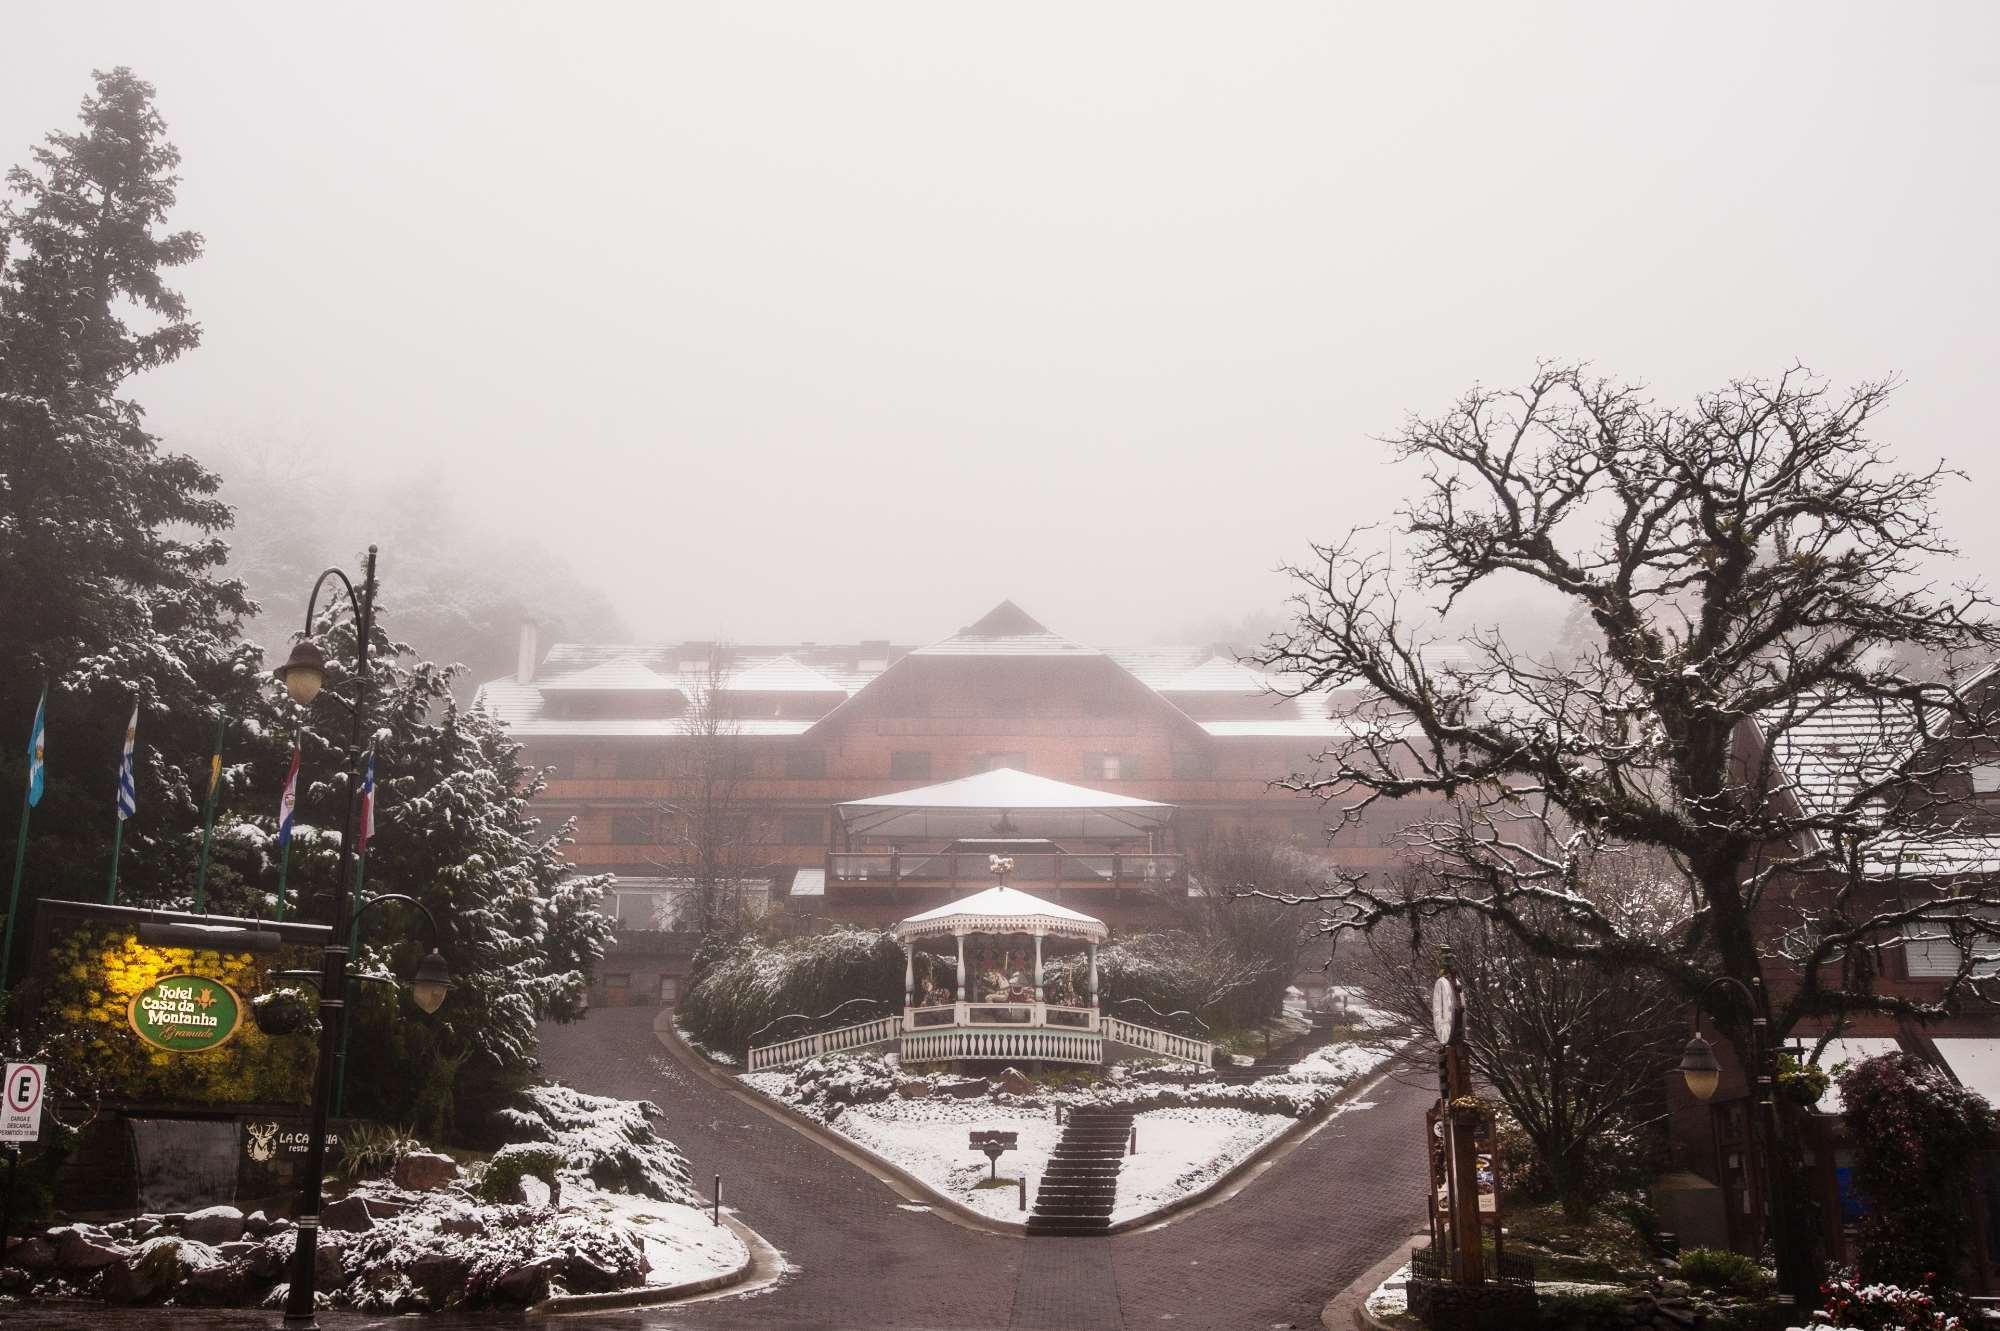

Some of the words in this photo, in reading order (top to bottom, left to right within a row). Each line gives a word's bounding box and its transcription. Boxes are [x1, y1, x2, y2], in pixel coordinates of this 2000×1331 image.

[141, 996, 176, 1011] Casa
[178, 999, 195, 1013] da
[148, 1009, 218, 1026] Montanha
[18, 1076, 31, 1102] E
[279, 1133, 293, 1144] LA
